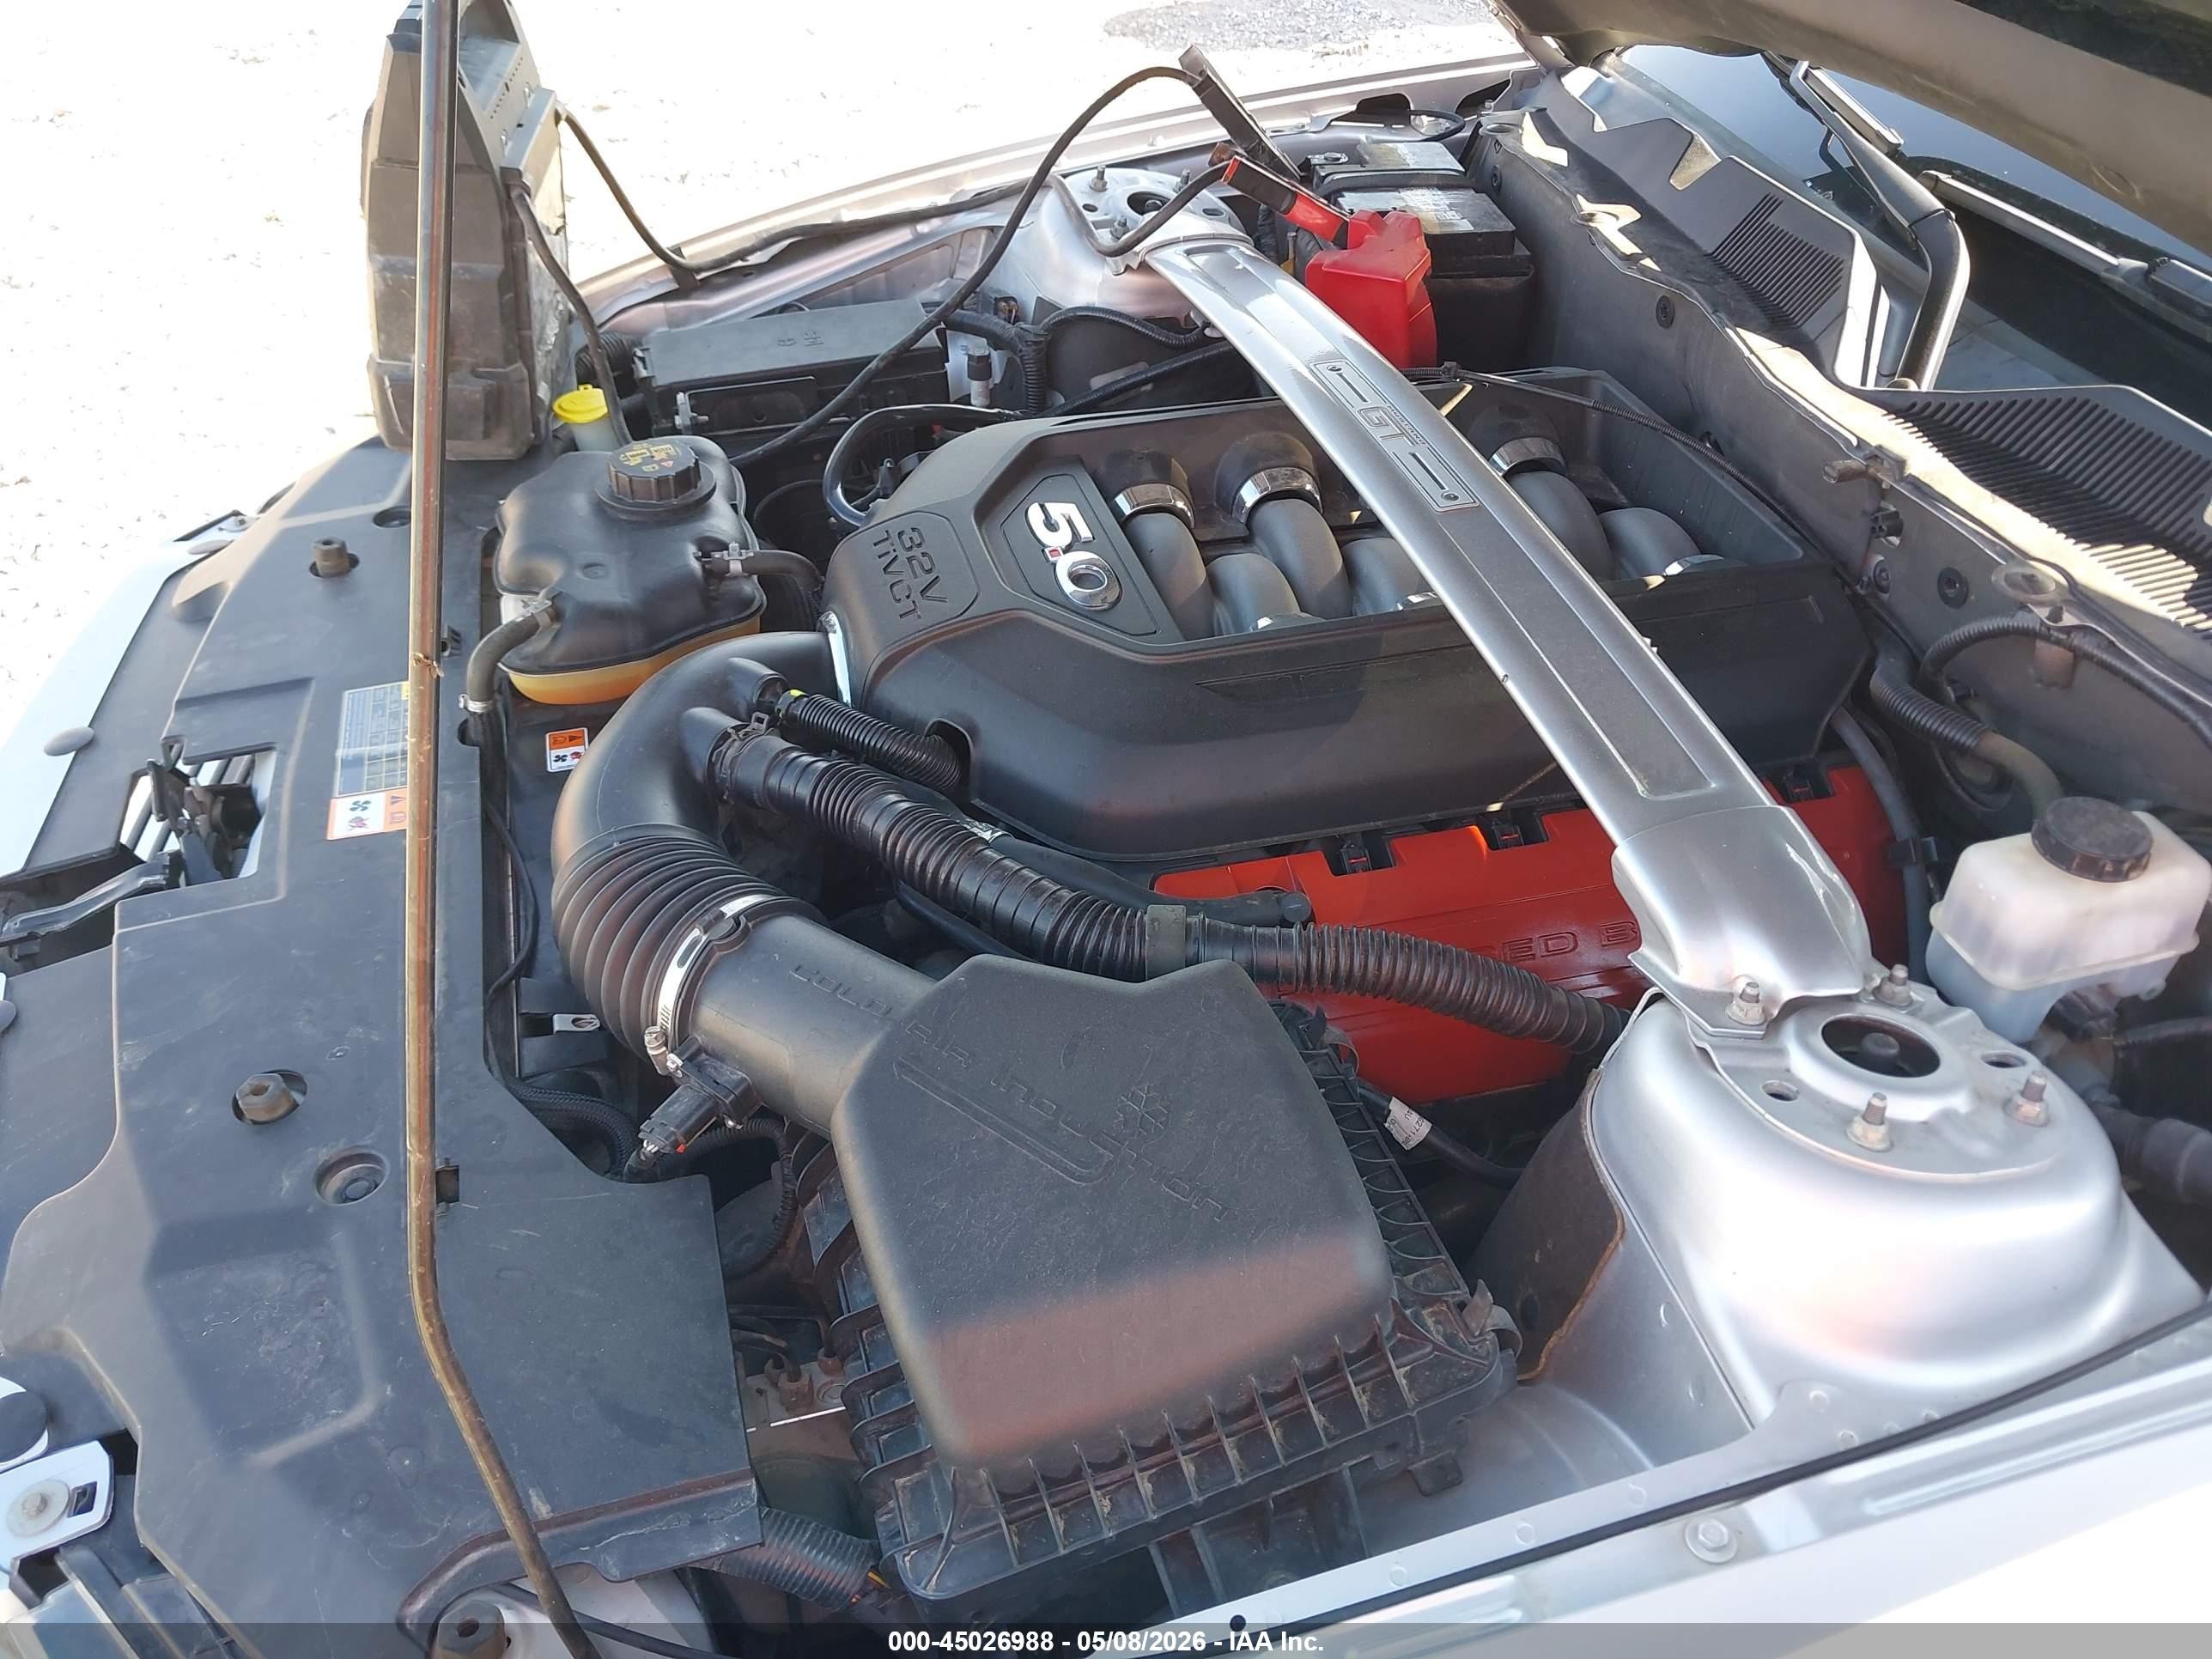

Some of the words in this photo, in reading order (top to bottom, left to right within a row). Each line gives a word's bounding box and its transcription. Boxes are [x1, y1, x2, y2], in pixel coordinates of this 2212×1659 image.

[1356, 405, 1420, 447] GT
[872, 529, 921, 620] TiVCT
[896, 526, 948, 604] 32V
[1025, 501, 1122, 611] 5.0
[1503, 931, 1578, 961] ED
[1599, 920, 1638, 947] B
[789, 964, 893, 1018] COLD
[905, 1019, 973, 1068] AIR
